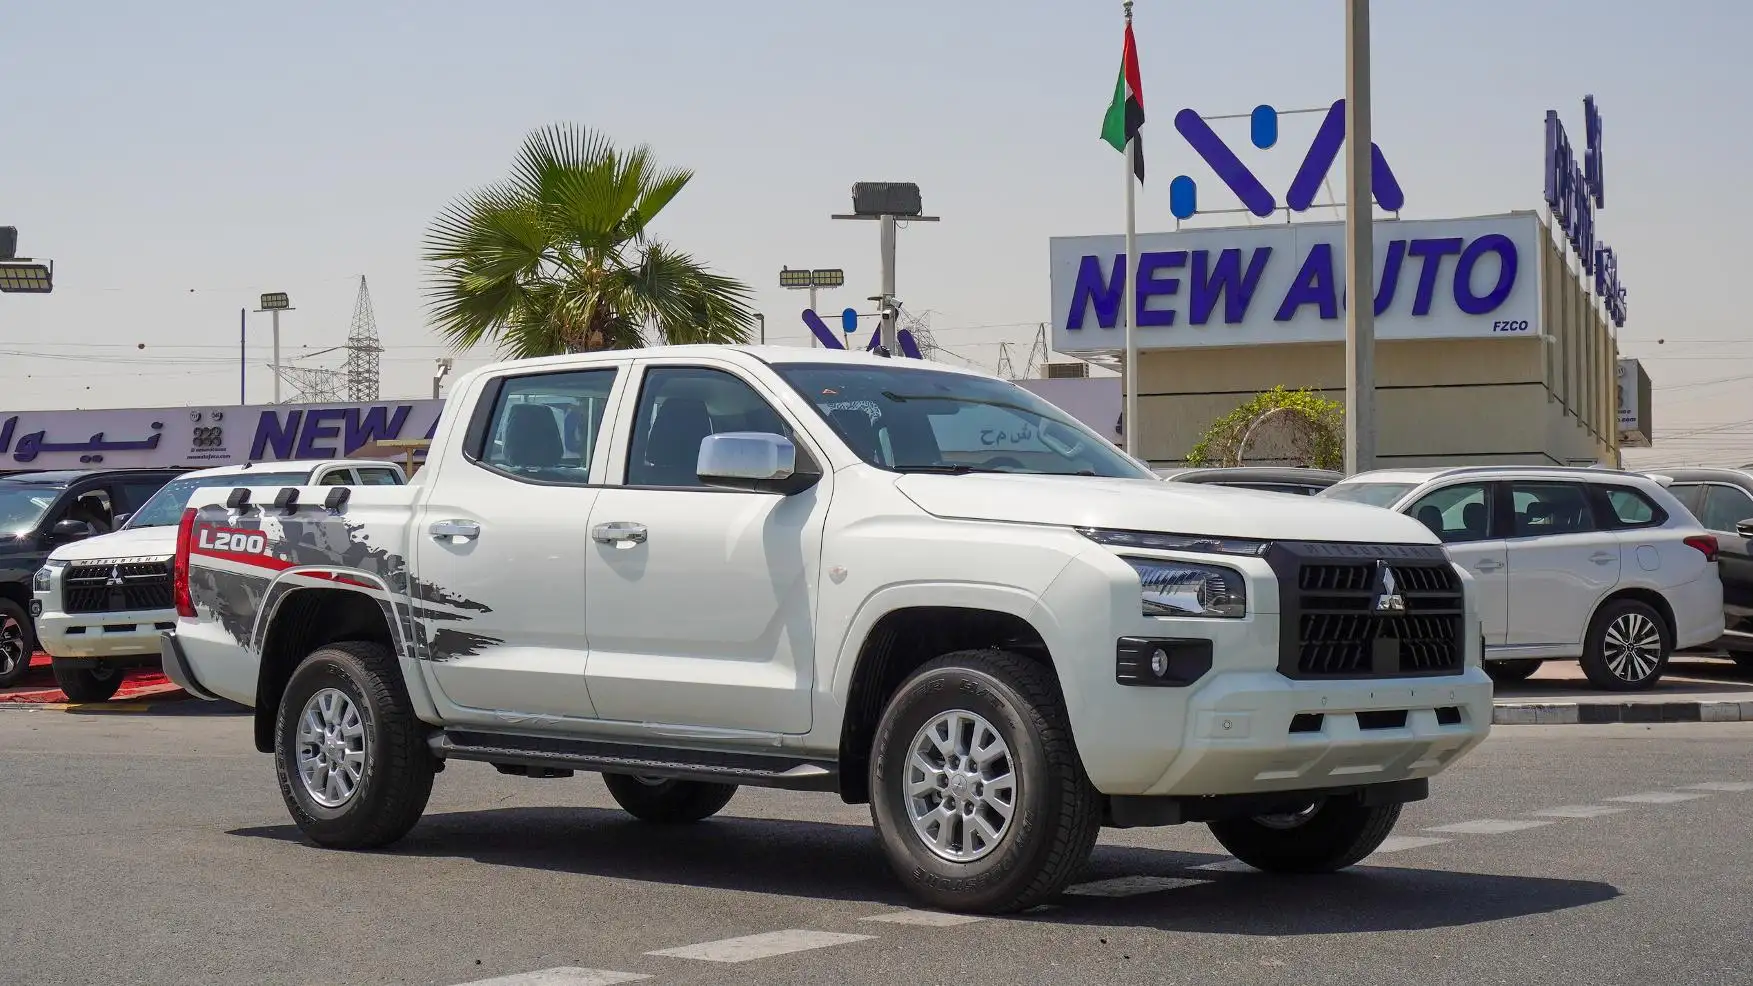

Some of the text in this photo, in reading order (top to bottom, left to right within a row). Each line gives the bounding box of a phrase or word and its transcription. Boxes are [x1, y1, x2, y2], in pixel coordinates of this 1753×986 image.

[1065, 246, 1273, 331] NEW
[1273, 233, 1519, 323] AUTO
[1493, 320, 1529, 332] FZCO
[249, 406, 413, 461] NEW
[199, 529, 265, 554] L200
[80, 557, 159, 566] MITSUBISHI
